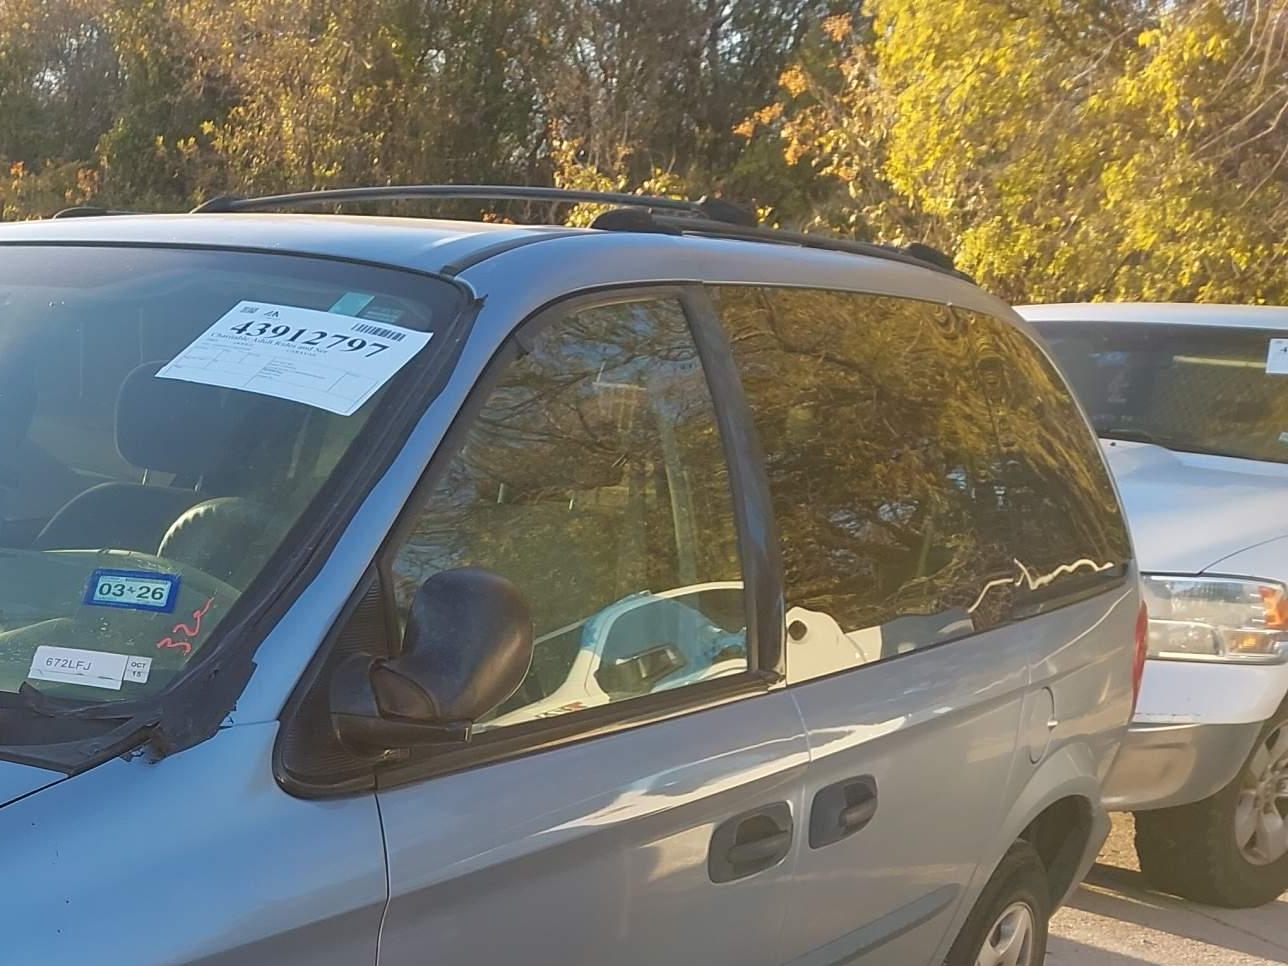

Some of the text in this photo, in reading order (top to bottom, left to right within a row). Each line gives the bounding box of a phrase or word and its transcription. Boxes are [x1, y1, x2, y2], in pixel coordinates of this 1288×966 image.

[230, 320, 391, 358] 43912797
[98, 582, 165, 600] 03 26
[46, 657, 92, 671] 672LFJ
